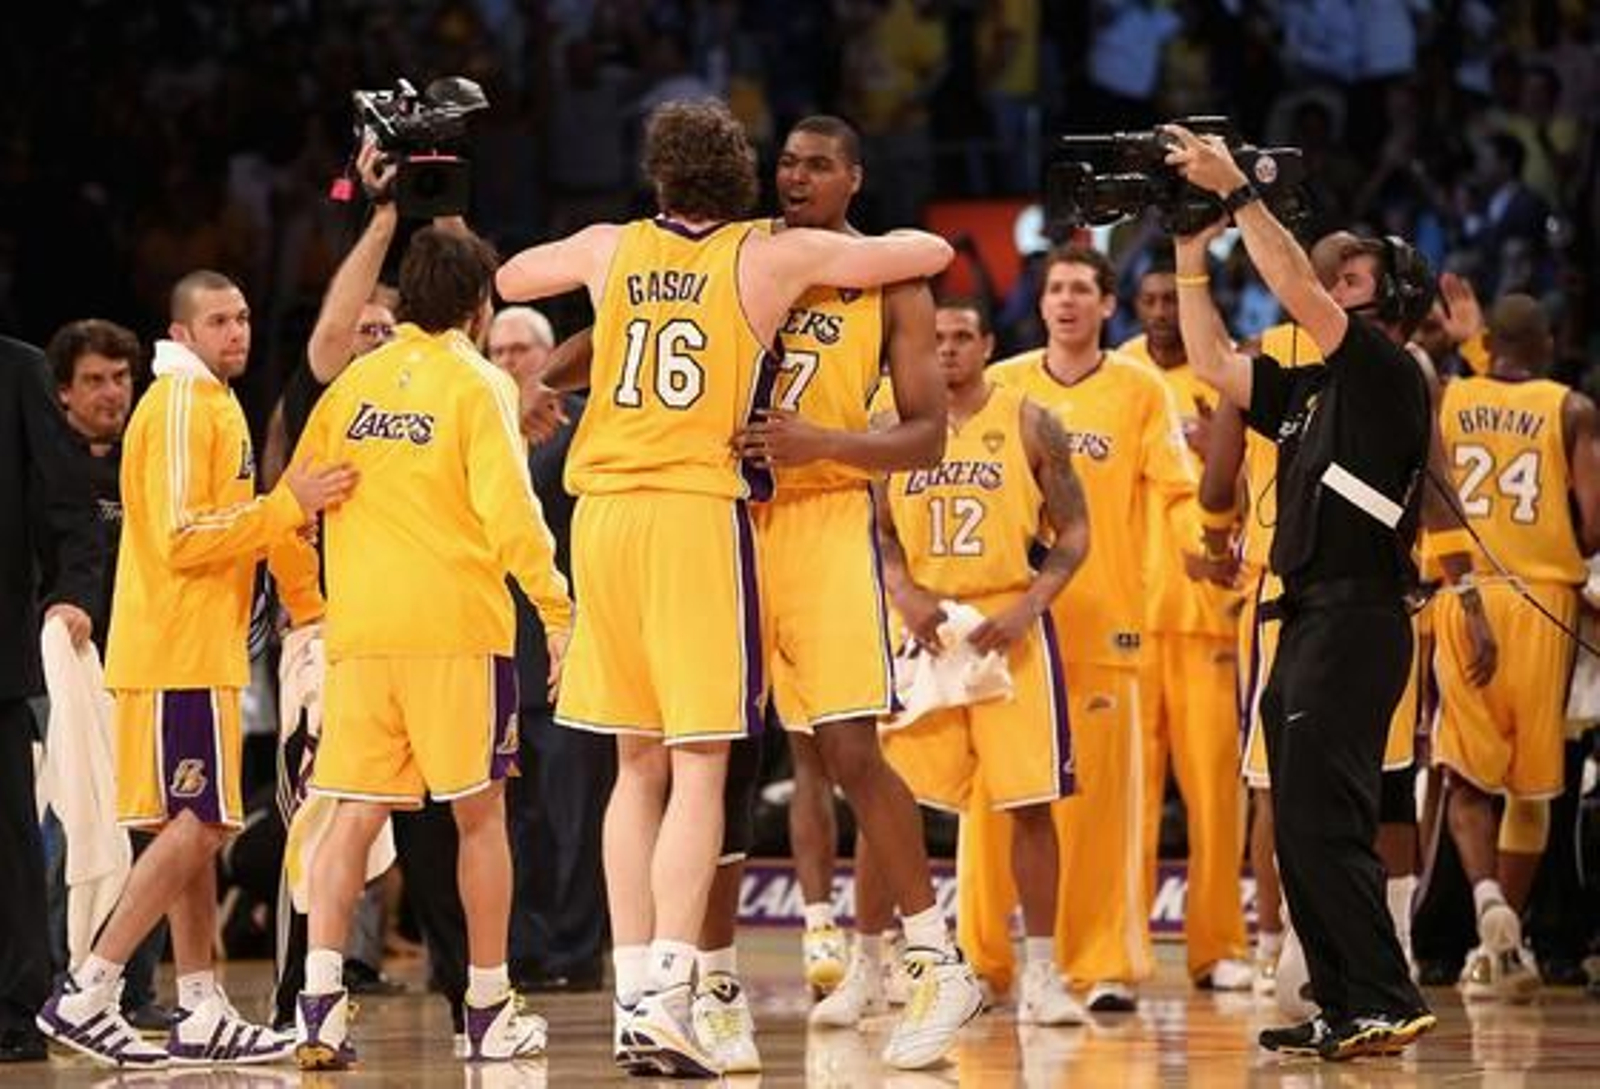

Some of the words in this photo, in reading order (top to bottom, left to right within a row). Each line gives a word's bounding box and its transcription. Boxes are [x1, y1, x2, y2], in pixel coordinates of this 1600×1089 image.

[627, 270, 708, 305] GASOL
[615, 318, 707, 410] 16
[347, 403, 434, 445] LAKERS
[906, 461, 1003, 495] LAKERS
[1453, 442, 1542, 525] 24
[930, 497, 986, 556] 12
